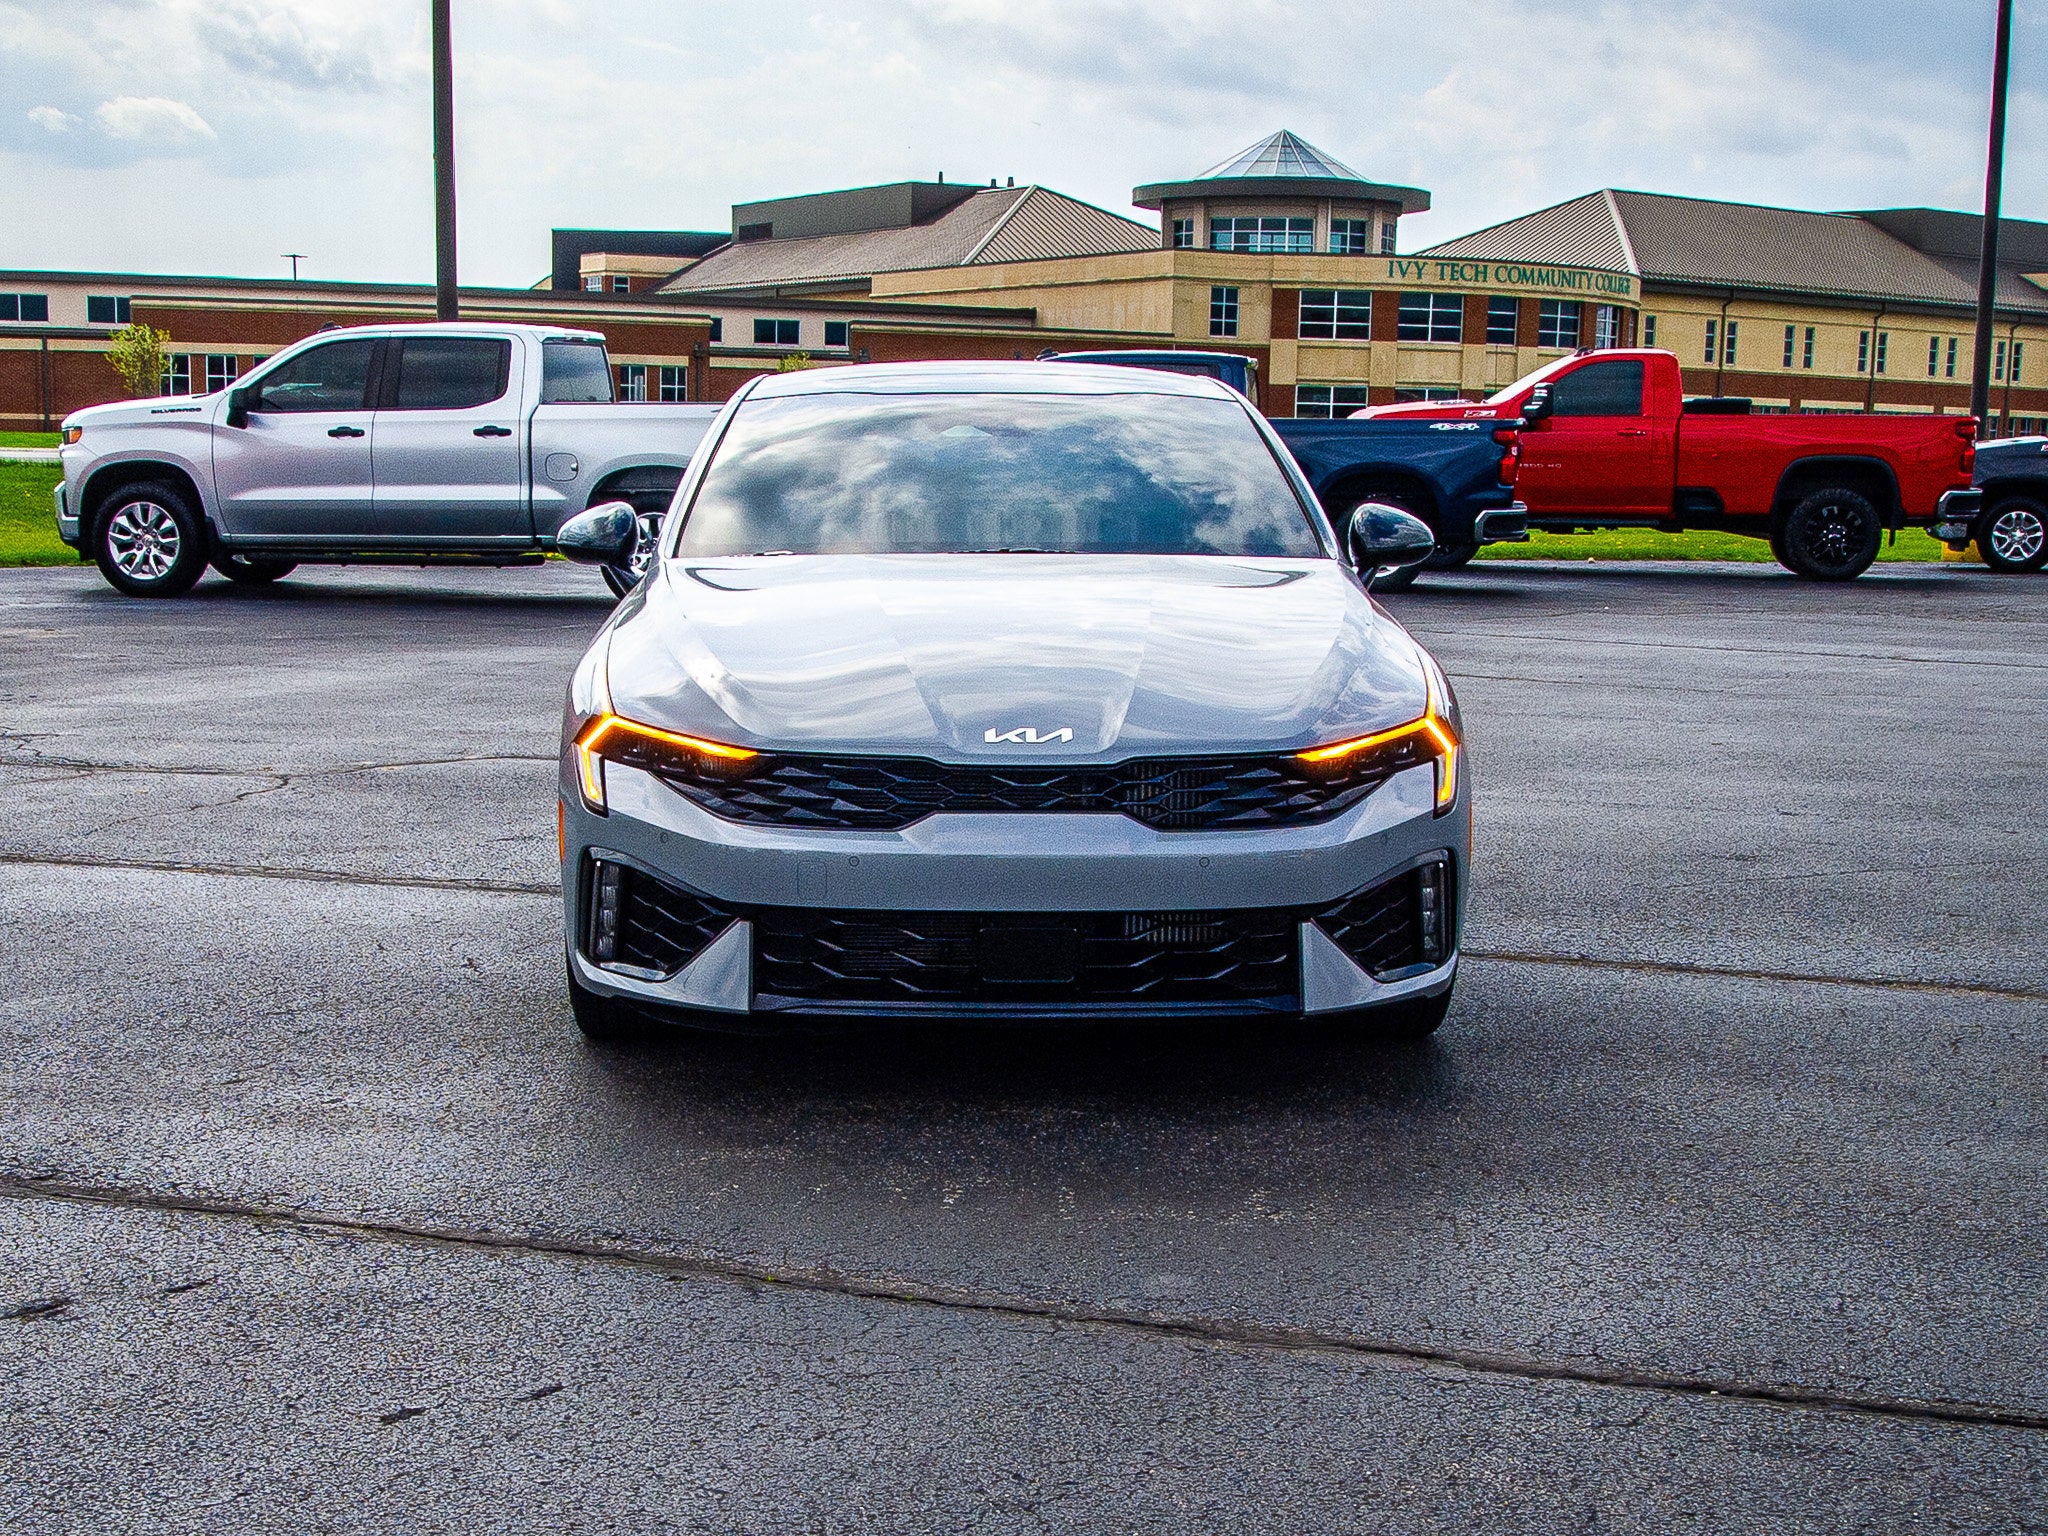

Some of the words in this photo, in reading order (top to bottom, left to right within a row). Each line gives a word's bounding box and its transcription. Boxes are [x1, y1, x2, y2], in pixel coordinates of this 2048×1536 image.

[1388, 260, 1428, 280] IVY
[1435, 261, 1489, 283] TECH
[1494, 264, 1594, 291] COMMUNITY
[1595, 273, 1631, 295] COLLEGE
